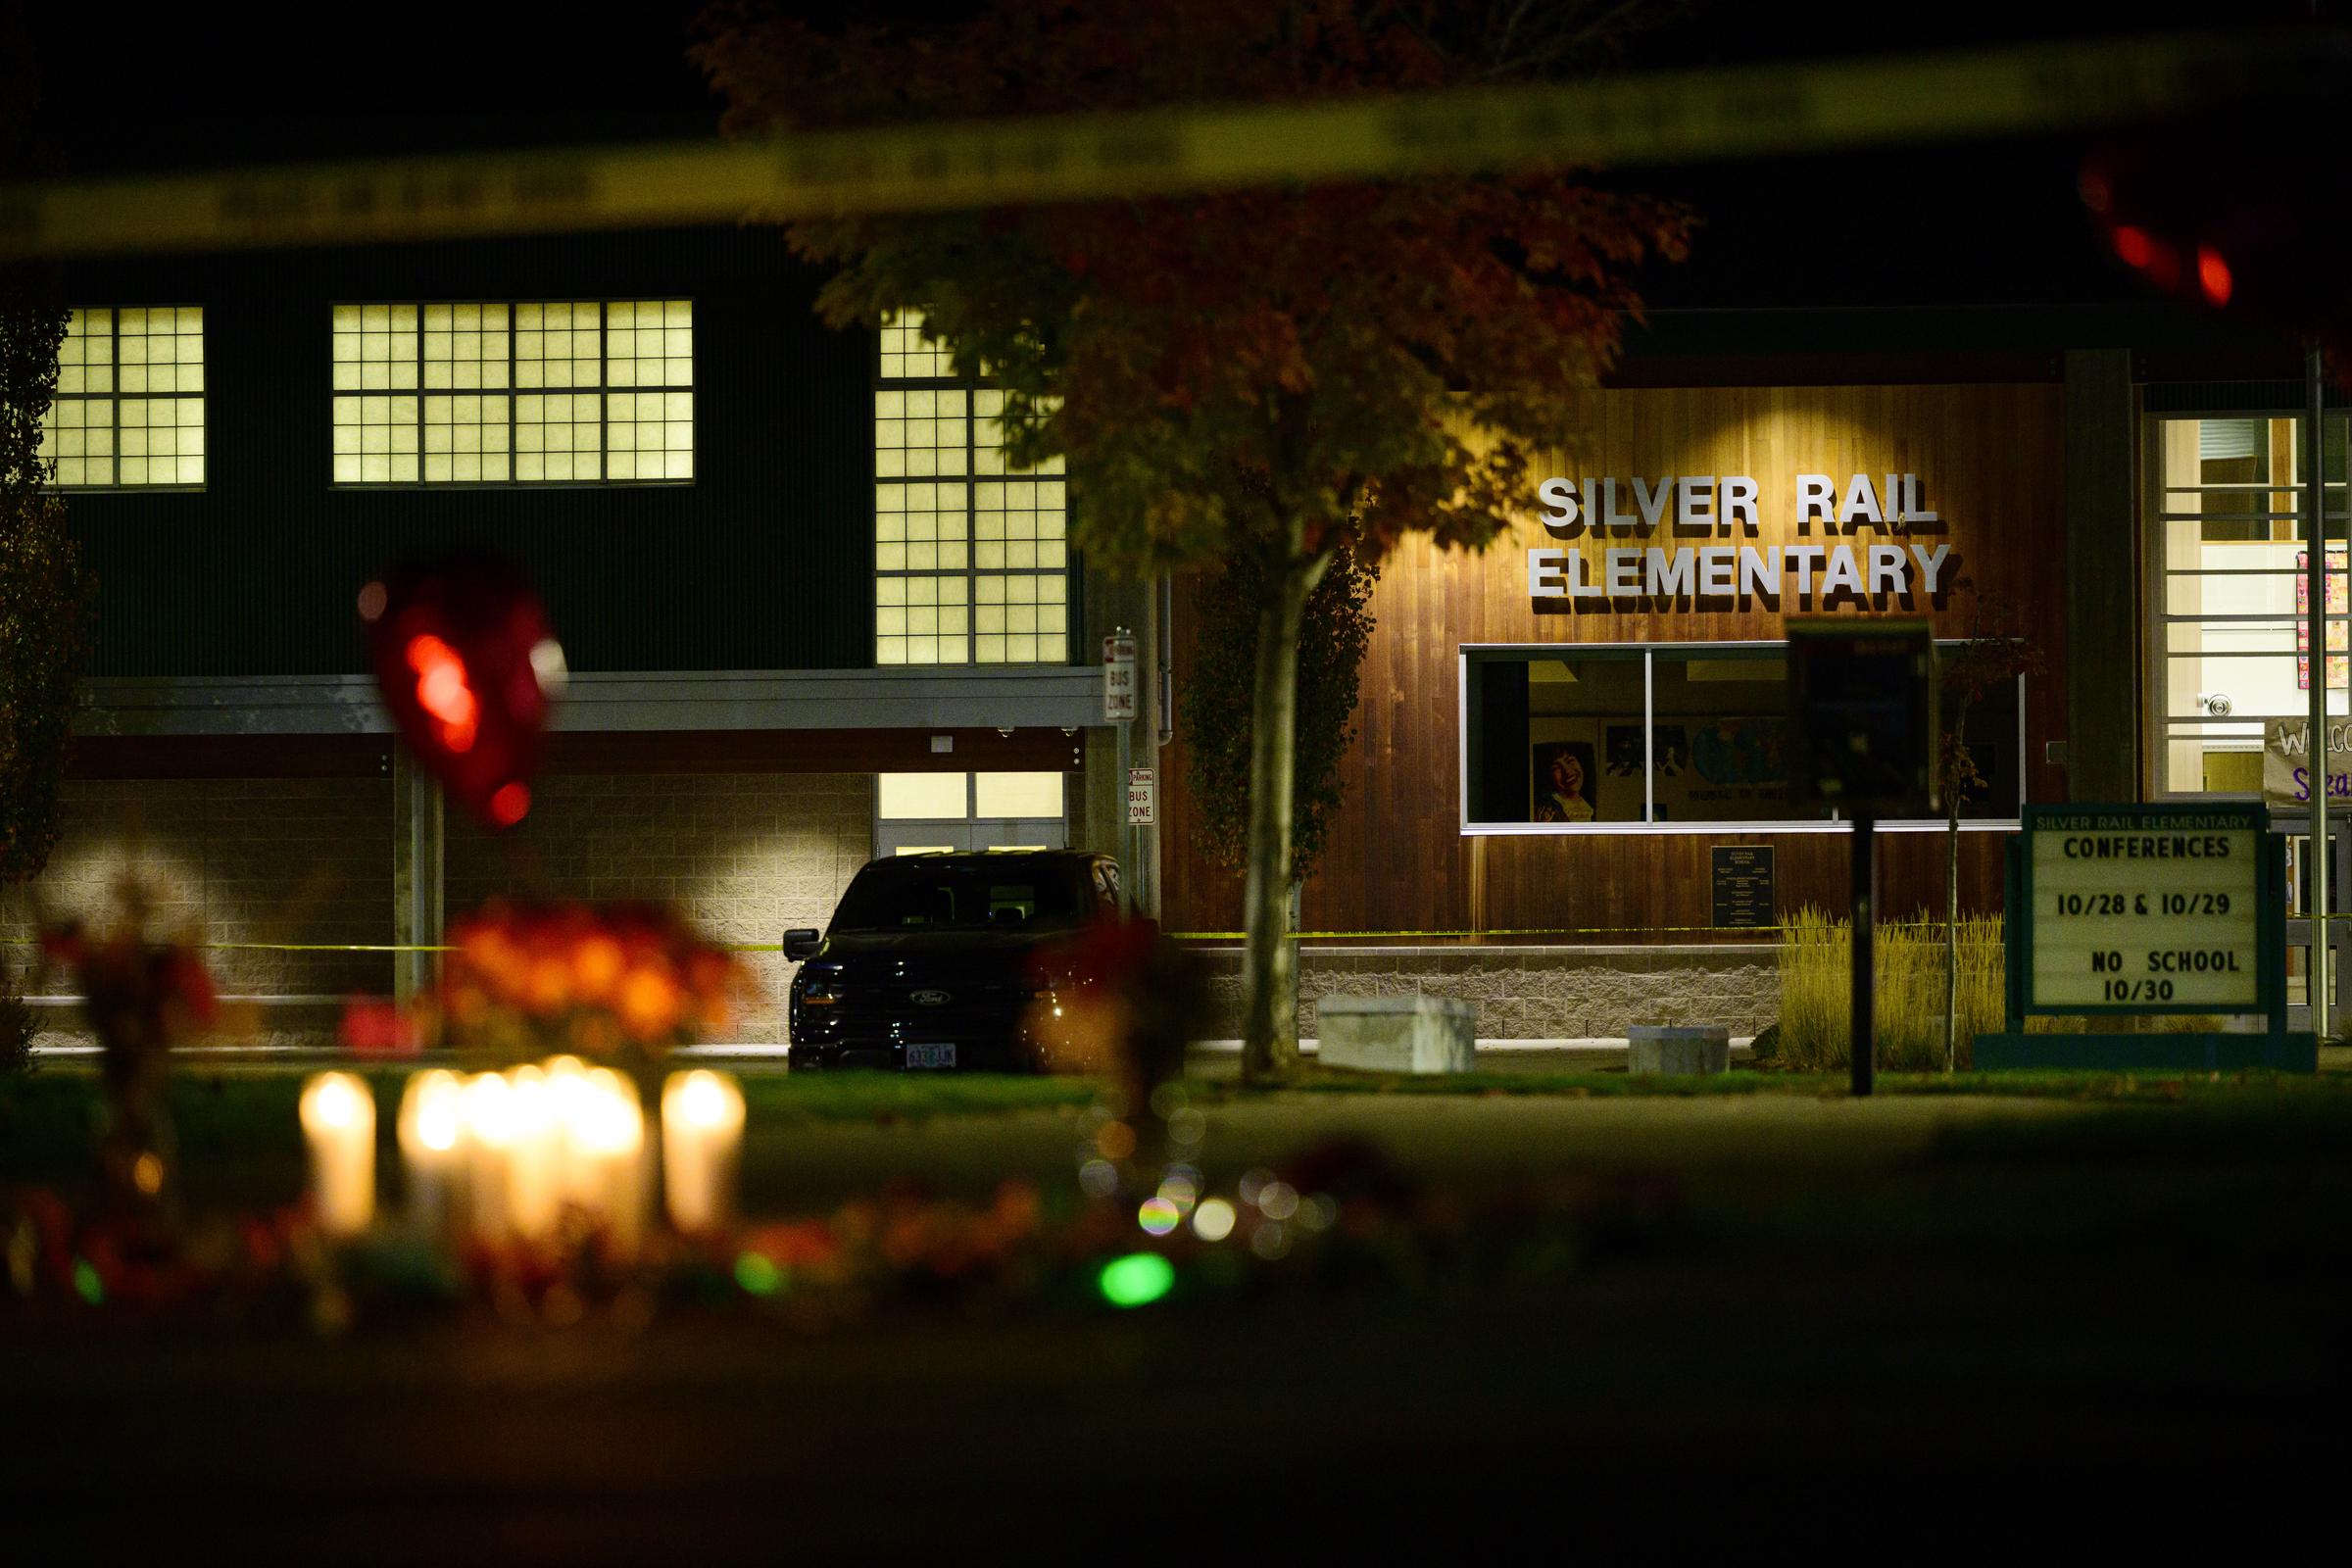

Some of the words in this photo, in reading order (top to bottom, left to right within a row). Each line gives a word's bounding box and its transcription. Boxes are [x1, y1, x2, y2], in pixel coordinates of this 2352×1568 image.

[1538, 475, 1759, 527] SILVER
[1796, 472, 1938, 523] RAIL
[1528, 543, 1951, 597] ELEMENTARY
[1110, 670, 1129, 686] BUS
[1107, 694, 1133, 710] ZONE
[1129, 791, 1148, 802] BUS
[2035, 815, 2091, 830] SILVER
[2096, 815, 2133, 830] RAIL
[2141, 814, 2251, 830] ELEMENTARY
[2064, 837, 2230, 858] CONFERENCES
[2058, 894, 2126, 914] 10/28
[2134, 894, 2148, 914] &
[2162, 894, 2230, 914] 10/29
[2092, 952, 2123, 971] NO
[2148, 951, 2240, 971] SCHOOL
[2105, 980, 2174, 1001] 10/30
